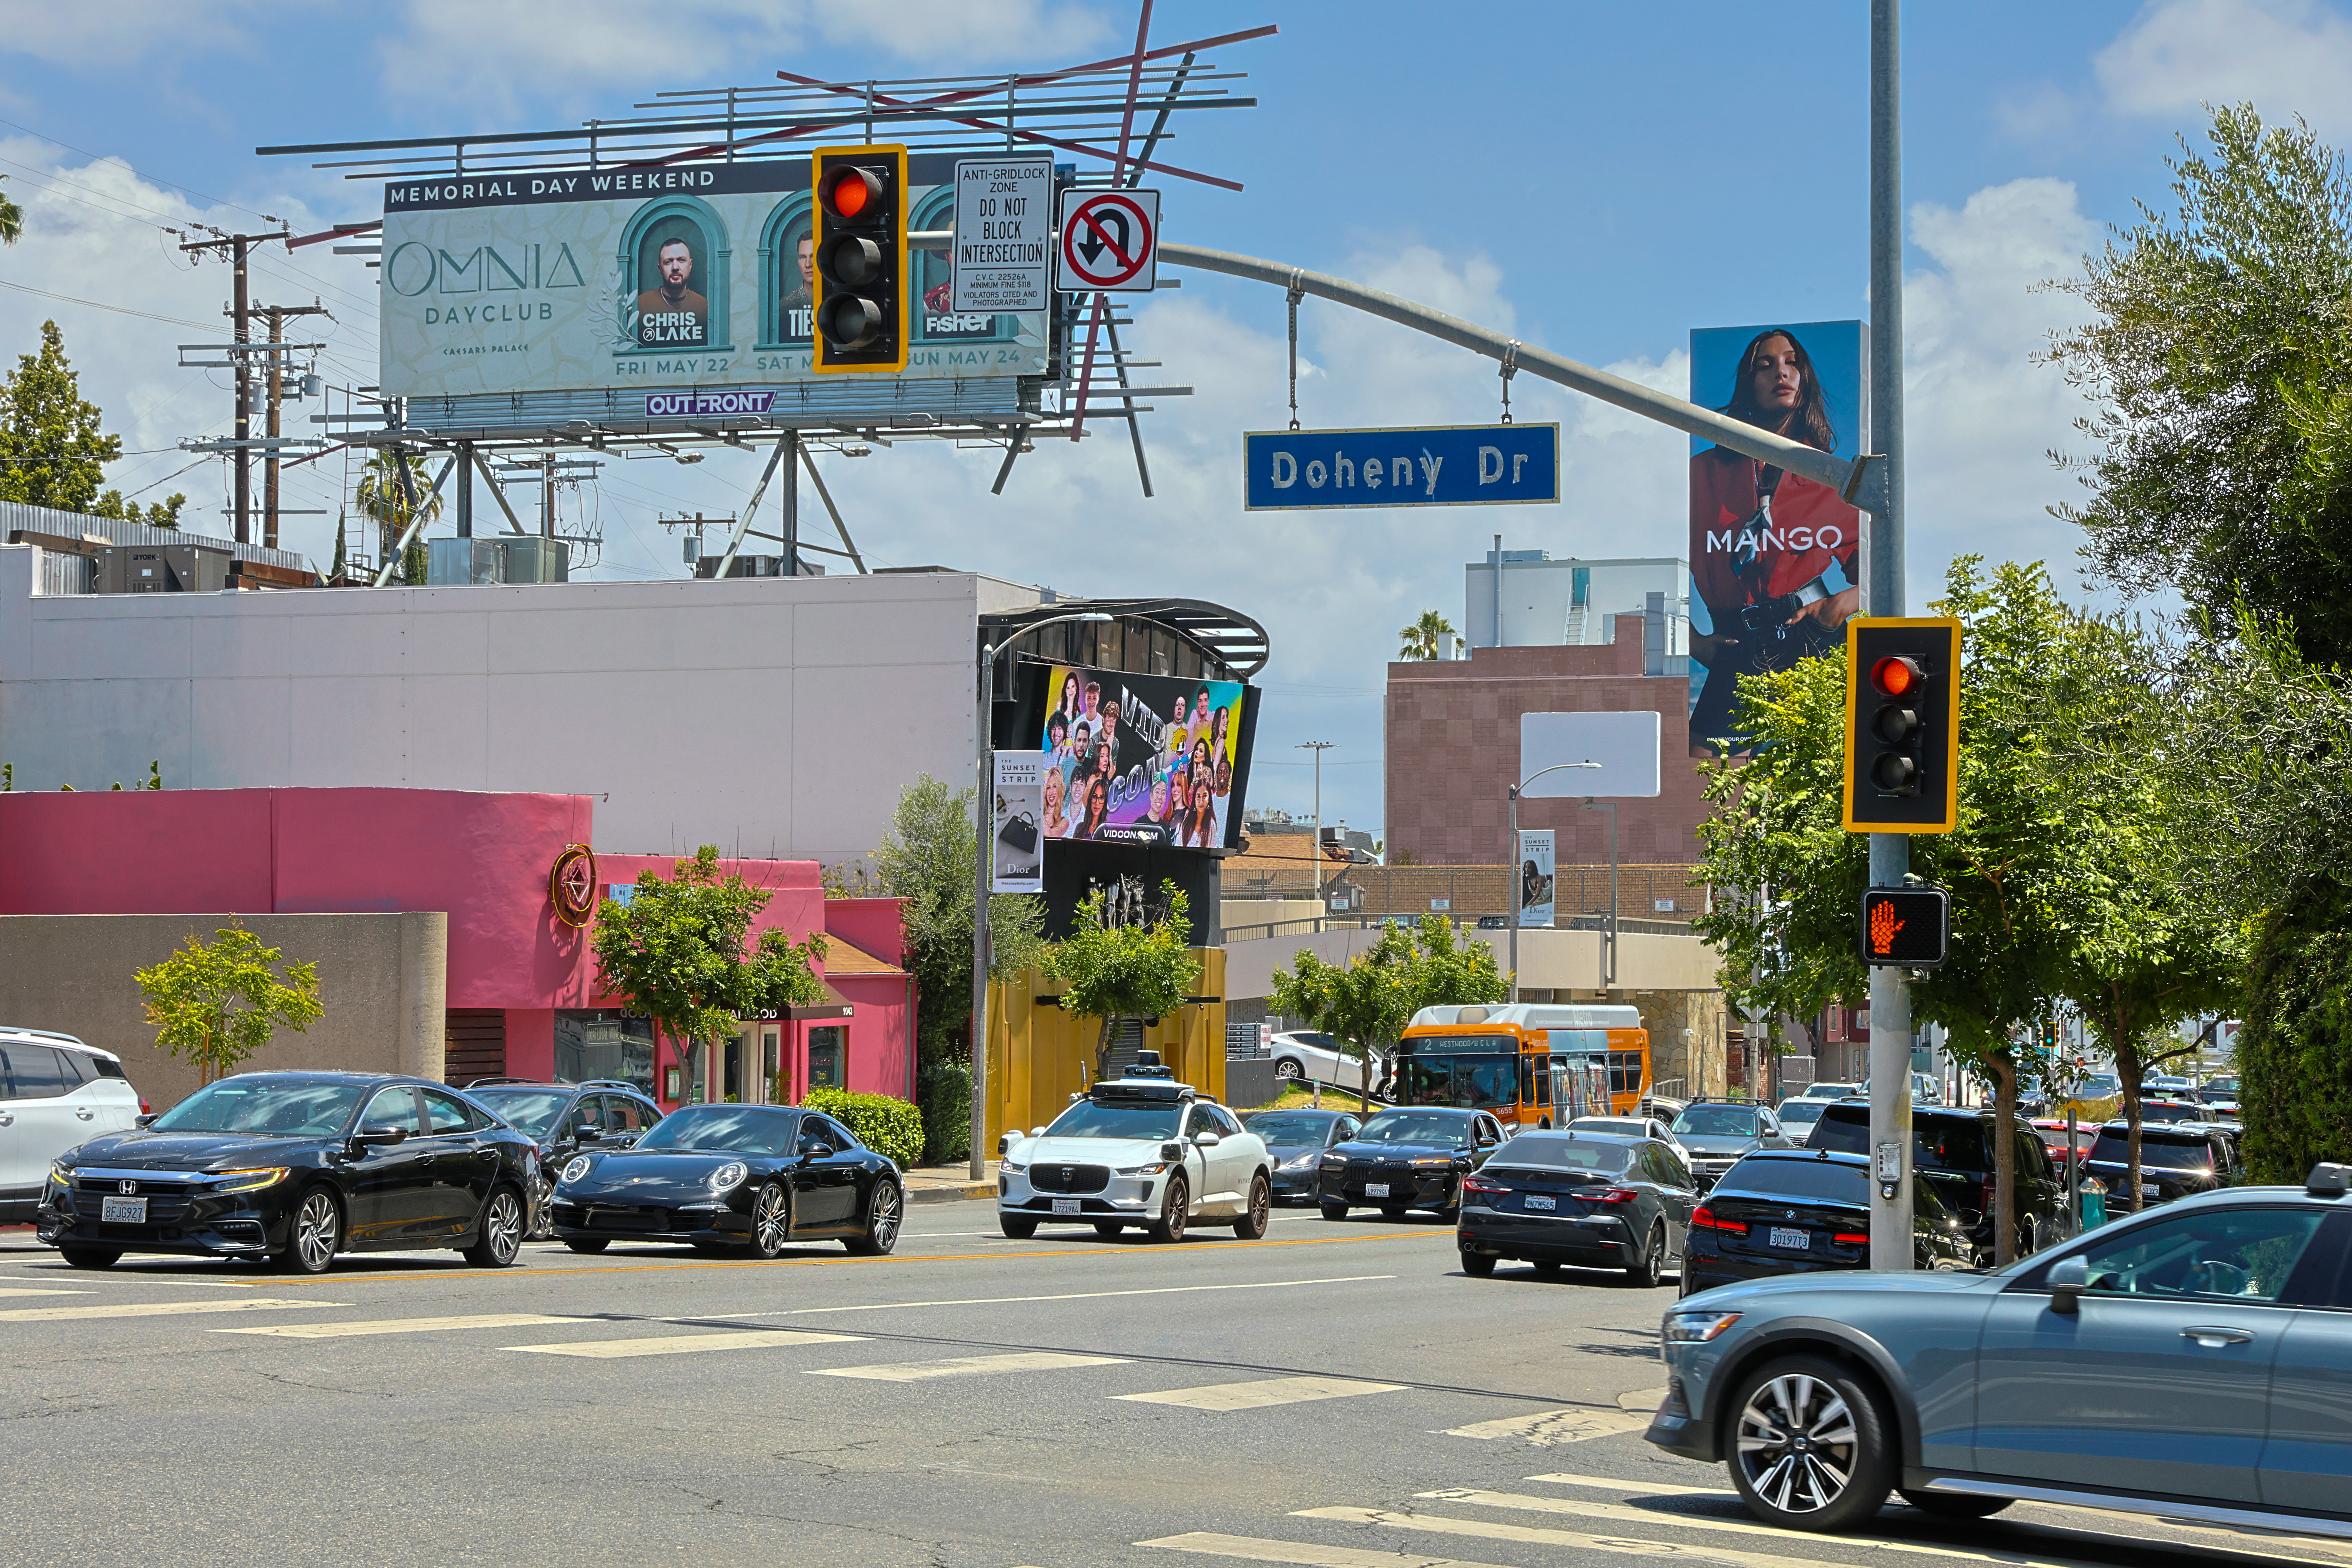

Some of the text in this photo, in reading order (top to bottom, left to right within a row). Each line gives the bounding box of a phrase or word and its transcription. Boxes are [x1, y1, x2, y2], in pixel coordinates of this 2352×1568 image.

[963, 168, 1045, 180] ANTI-GRIDLOCK
[391, 171, 714, 203] MEMORIAL DAY WEEKEND
[990, 182, 1018, 192] ZONE
[980, 198, 1027, 217] DO NOT
[983, 221, 1022, 240] BLOCK
[961, 243, 1043, 263] INTERSECTION
[388, 241, 586, 296] OMNIA
[426, 303, 552, 325] DAYCLUB
[643, 312, 696, 327] CHRIS
[655, 326, 702, 341] LAKE
[443, 344, 528, 355] CAESARS PALACE
[757, 356, 793, 370] SAT
[949, 351, 990, 365] MAY
[998, 350, 1020, 363] 24
[616, 358, 729, 375] FRI MAY 22
[650, 393, 769, 414] OUTFRONT
[1272, 446, 1528, 495] Doheny Dr
[1707, 525, 1842, 553] MANGO
[1121, 684, 1167, 753] VID
[1104, 829, 1158, 840] VIDCON.M
[1007, 864, 1030, 873] Dior
[843, 1007, 853, 1016] 9043
[1572, 1006, 1593, 1027] Metro
[1425, 1038, 1432, 1051] 2
[1496, 1106, 1513, 1115] 5655
[105, 1206, 143, 1219] 8FJG927
[1054, 1205, 1078, 1214] 17219A4
[1771, 1234, 1808, 1247] 30197T3
